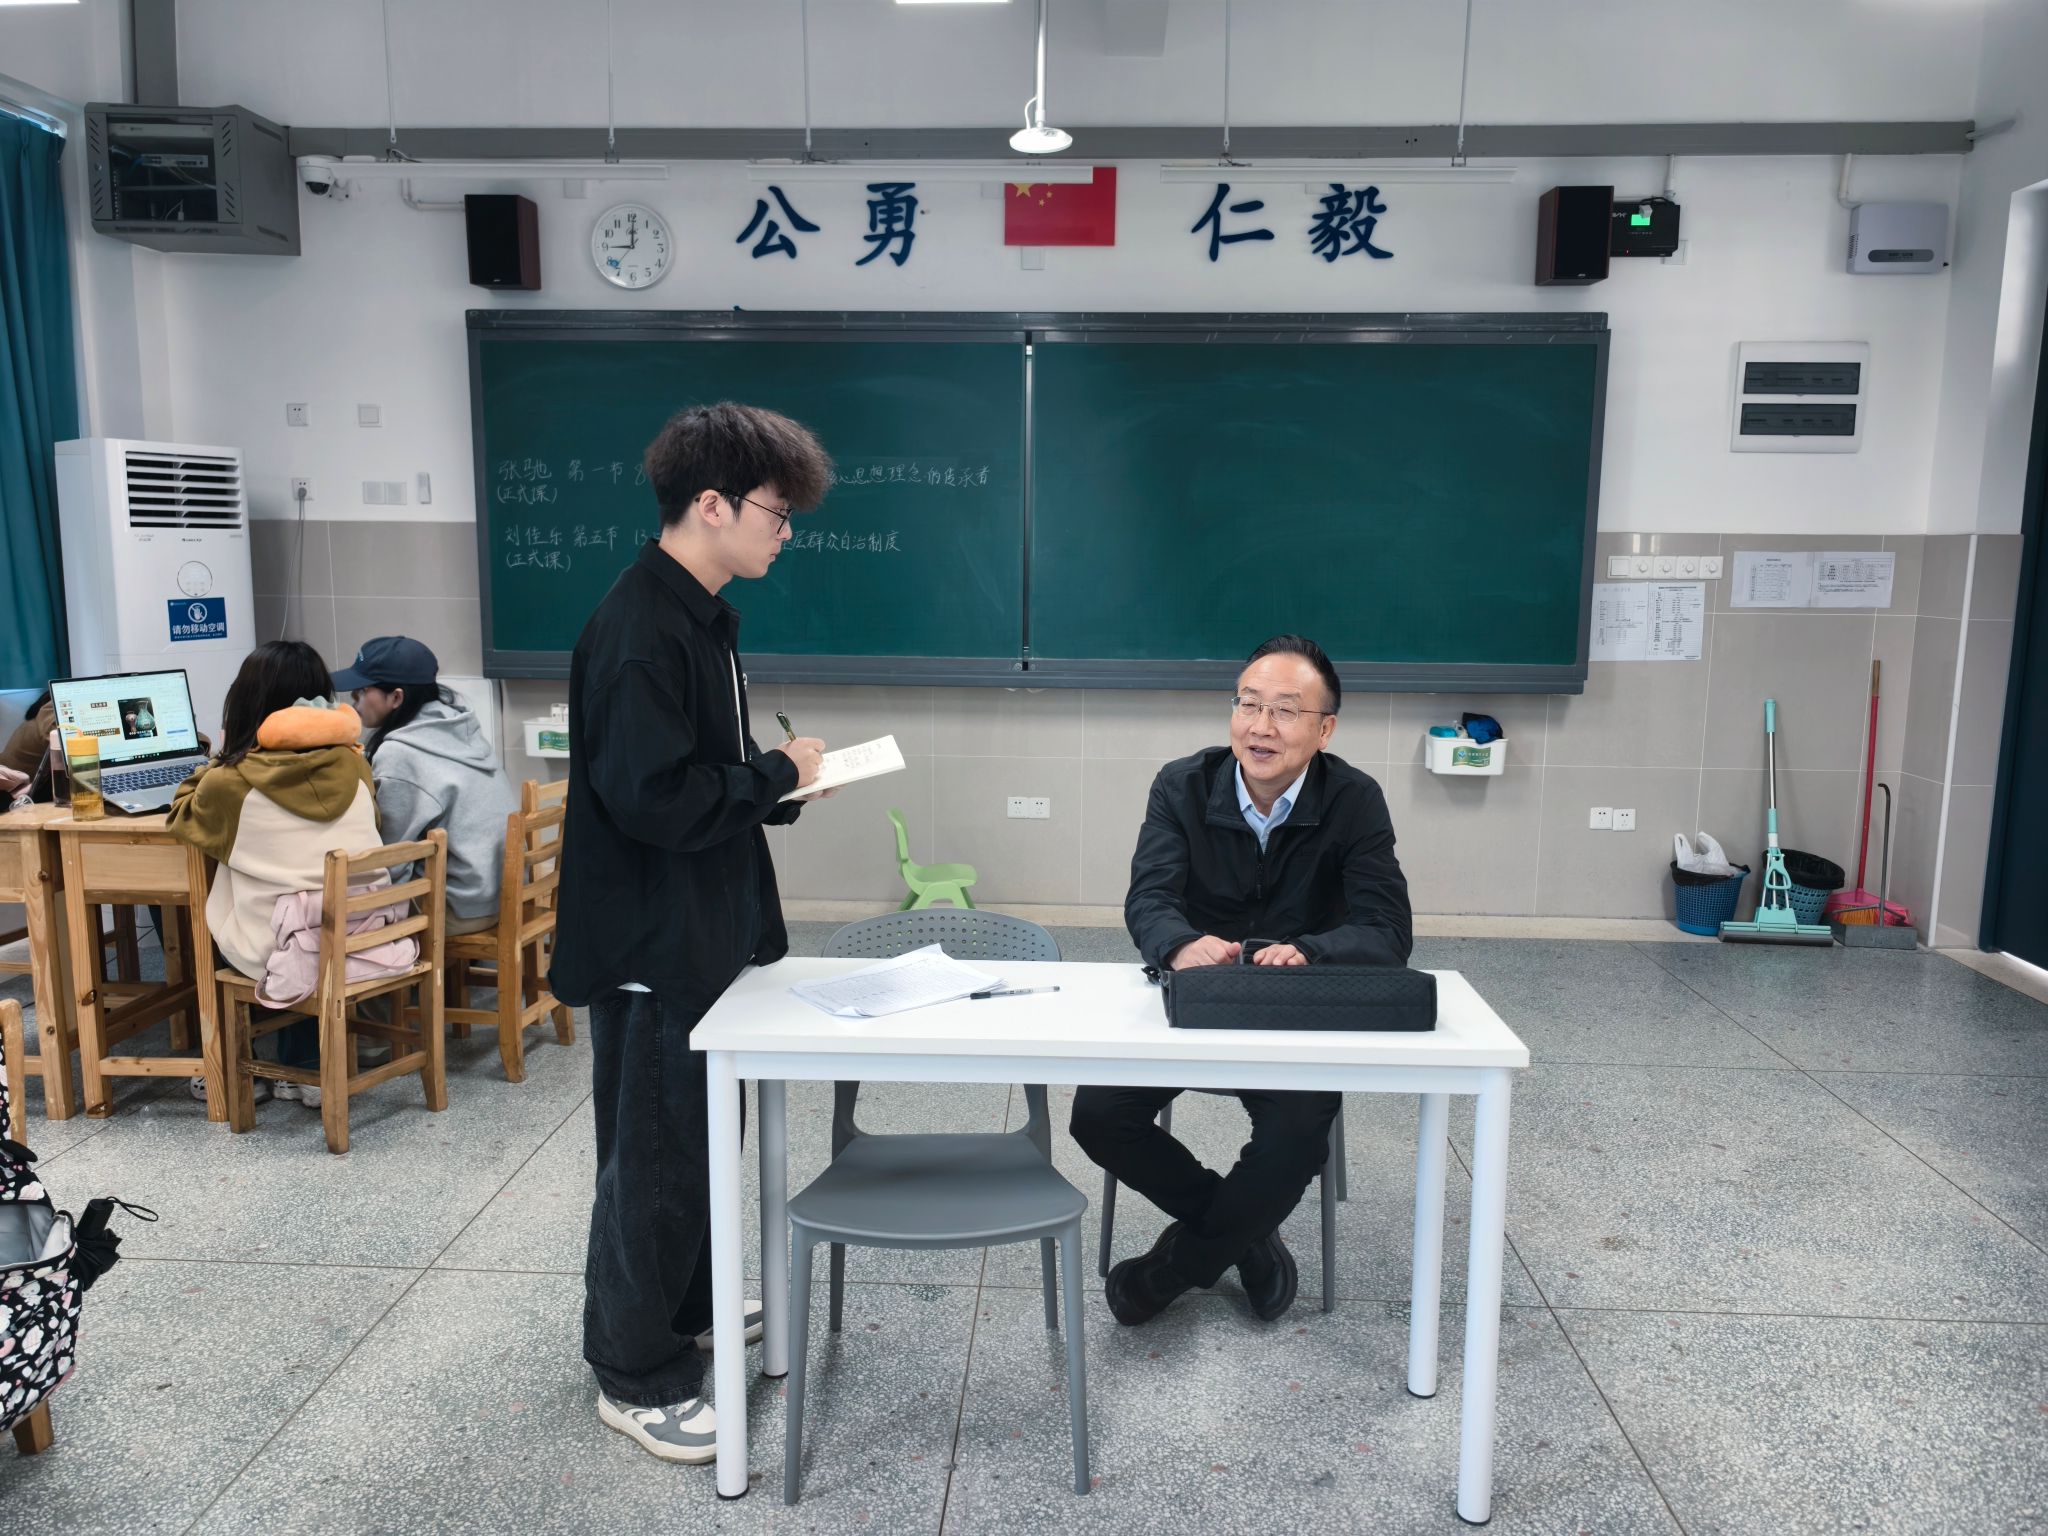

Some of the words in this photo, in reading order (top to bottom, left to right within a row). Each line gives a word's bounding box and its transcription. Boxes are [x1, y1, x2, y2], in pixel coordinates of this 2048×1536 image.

[614, 219, 621, 229] 11
[645, 219, 649, 229] 1
[605, 228, 614, 239] 10
[601, 241, 609, 251] 9
[656, 242, 664, 254] 3
[654, 258, 662, 268] 4
[630, 271, 637, 282] 6
[645, 267, 652, 277] 5
[498, 457, 553, 482] 张驰
[568, 458, 624, 485] 第一节
[504, 525, 563, 547] 刘佳乐
[573, 525, 619, 552] 第五节
[506, 550, 571, 572] (正式课)
[172, 622, 225, 635] 请勿移动空调
